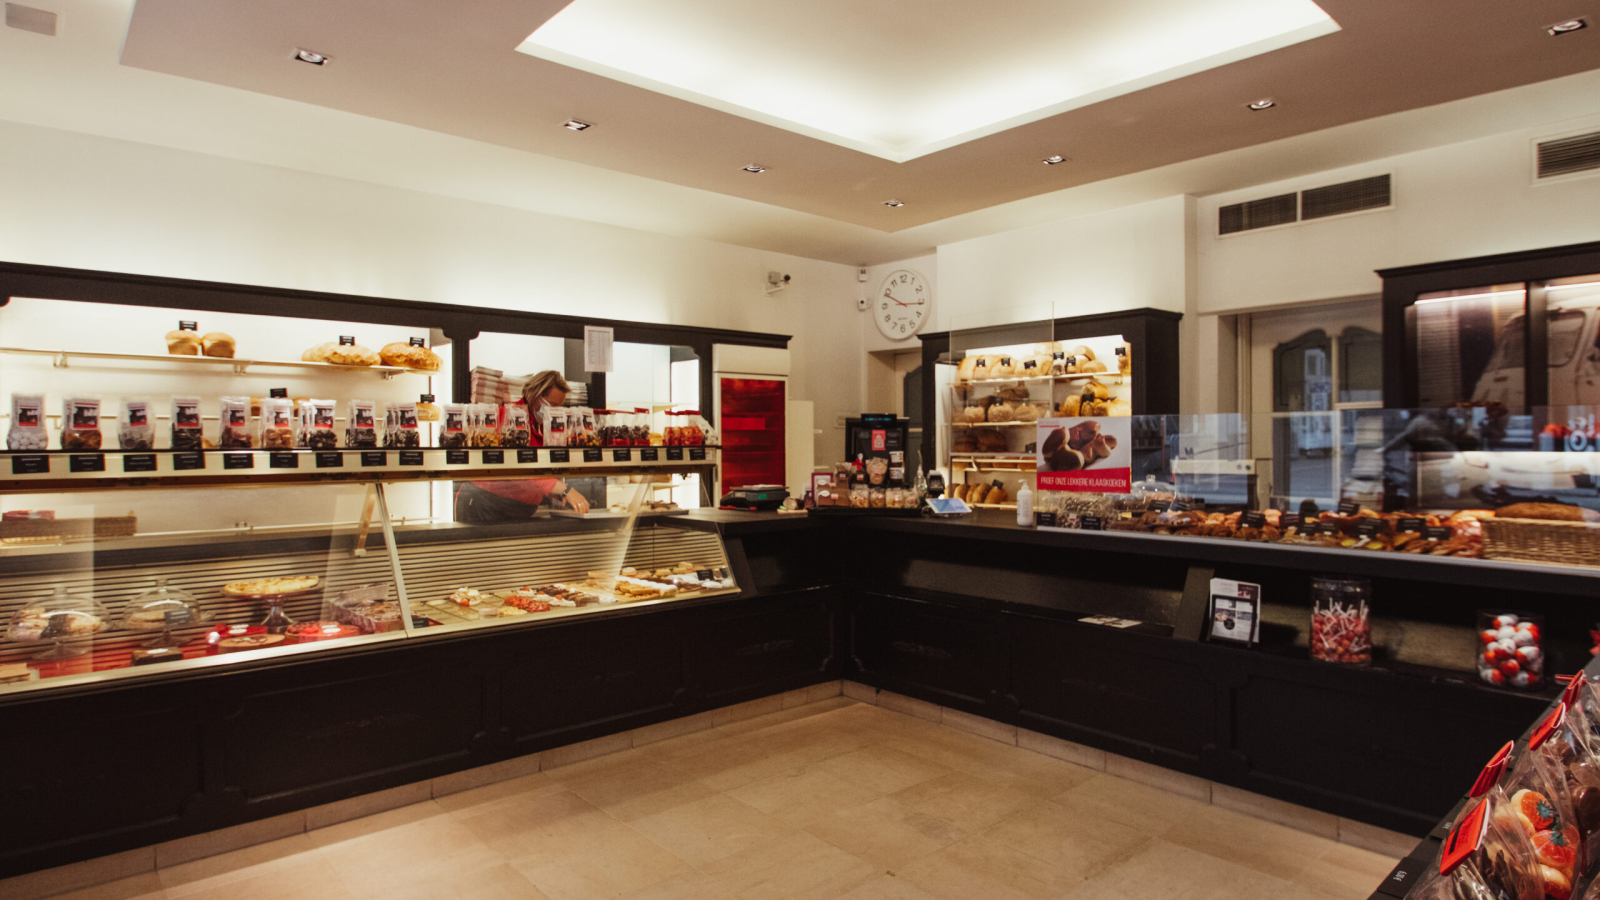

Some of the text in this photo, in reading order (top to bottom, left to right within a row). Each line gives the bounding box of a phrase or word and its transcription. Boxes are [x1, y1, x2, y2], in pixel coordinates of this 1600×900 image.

[891, 279, 897, 287] 11
[900, 274, 907, 283] 12
[911, 277, 915, 286] 1
[884, 288, 892, 299] 10
[915, 285, 923, 294] 2
[882, 302, 888, 310] 9
[885, 314, 891, 322] 8
[891, 321, 897, 330] 7
[900, 324, 906, 333] 6
[909, 320, 915, 329] 5
[1040, 476, 1126, 487] PROEF ONZE LEKKERE KLAASKOEKEN
